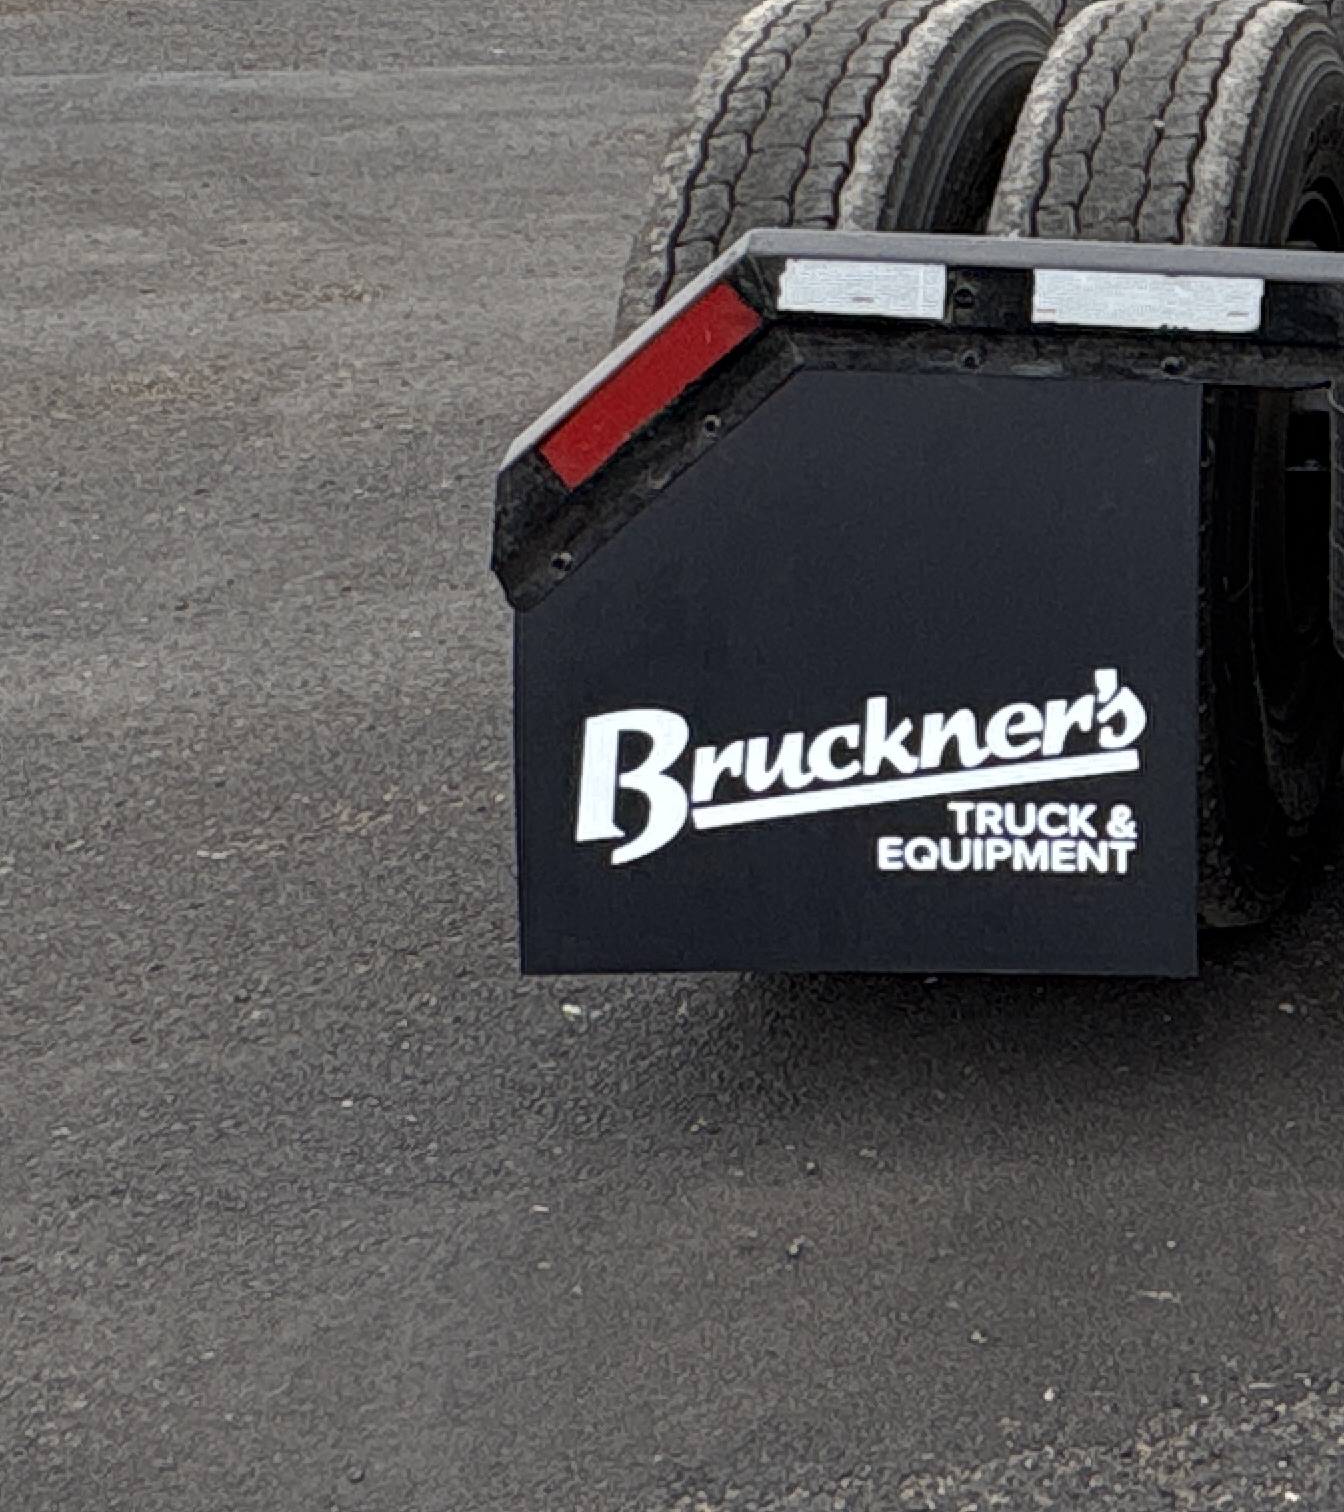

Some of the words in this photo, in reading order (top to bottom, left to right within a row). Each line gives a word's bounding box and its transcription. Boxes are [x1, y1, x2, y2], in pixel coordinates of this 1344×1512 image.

[575, 668, 1148, 866] Bruckner's
[946, 800, 1098, 838] TRUCK
[1105, 804, 1138, 840] &
[877, 836, 1136, 874] EQUIPMENT
